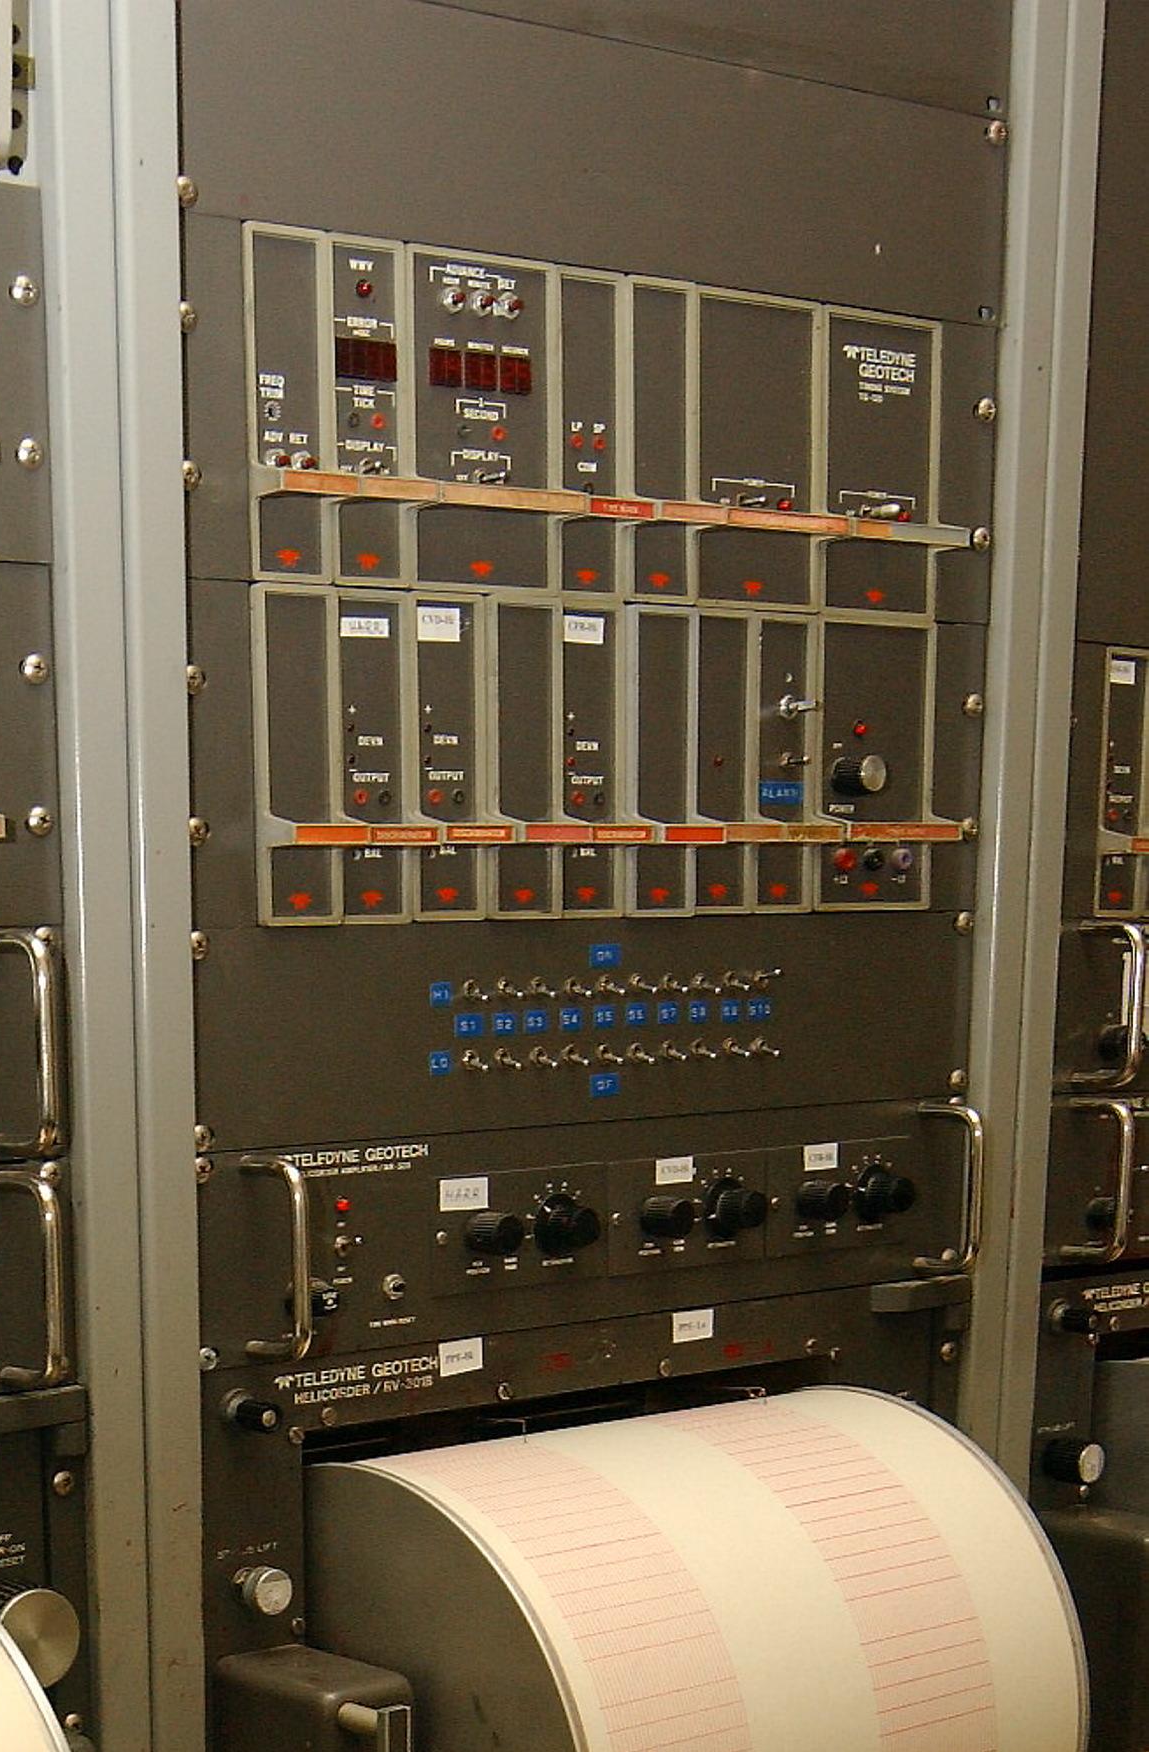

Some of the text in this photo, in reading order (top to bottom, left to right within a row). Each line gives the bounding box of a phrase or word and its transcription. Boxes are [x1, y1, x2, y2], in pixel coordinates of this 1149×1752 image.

[860, 347, 917, 368] TELEDYNE
[858, 363, 915, 383] GEOTECH
[293, 1144, 429, 1168] TELEDYNE GEOTECH
[293, 1355, 439, 1388] TELEDYNE GEOTECH
[293, 1383, 371, 1404] HELICORDER
